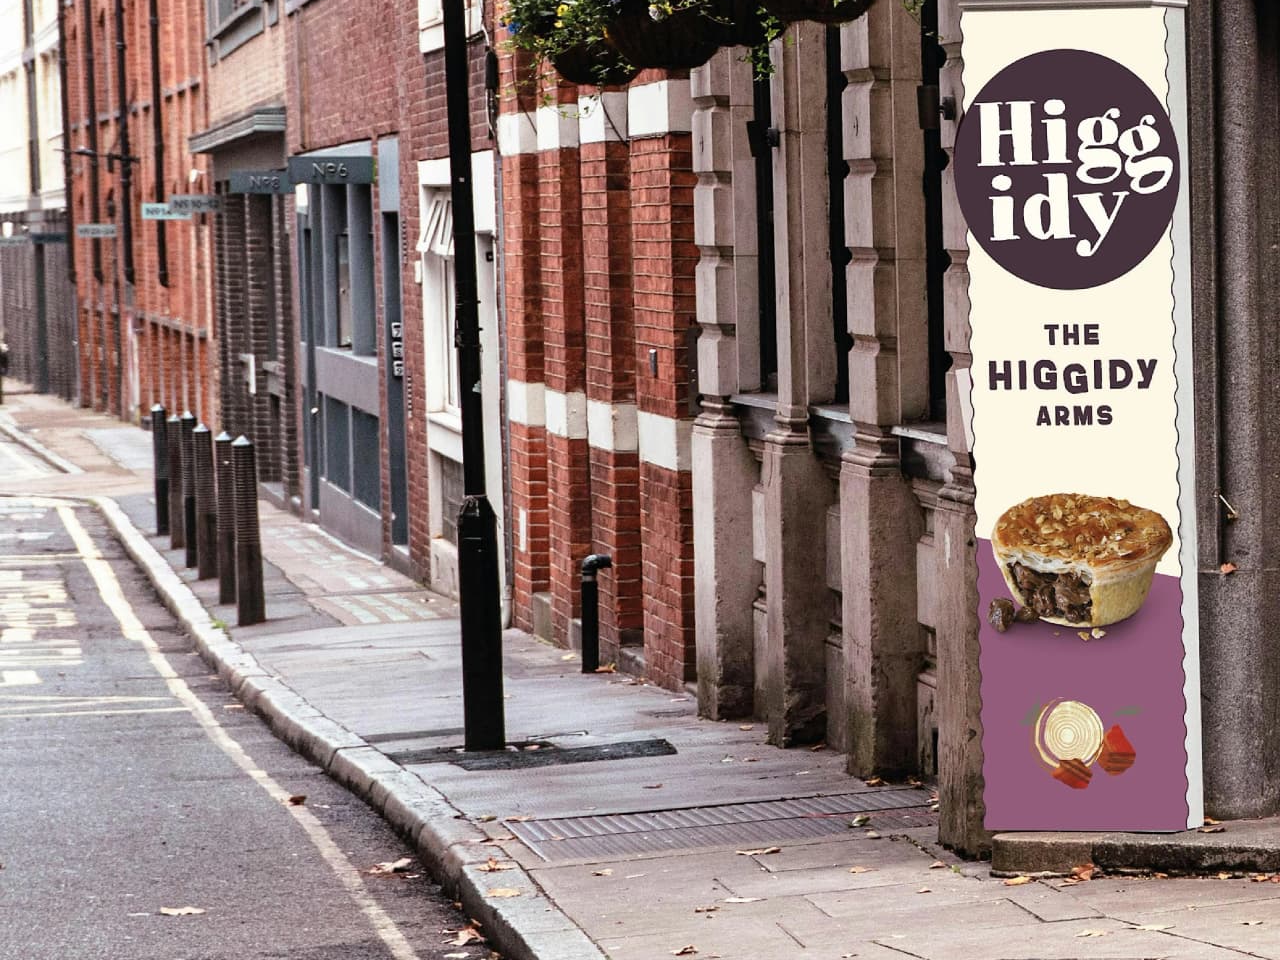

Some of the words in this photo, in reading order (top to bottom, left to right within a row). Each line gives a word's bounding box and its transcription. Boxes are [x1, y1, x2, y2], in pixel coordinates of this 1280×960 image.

[974, 98, 1175, 195] Higg
[989, 172, 1131, 258] idy
[1043, 323, 1101, 347] THE
[988, 358, 1158, 394] HIGGIDY
[1036, 405, 1114, 427] ARMS
